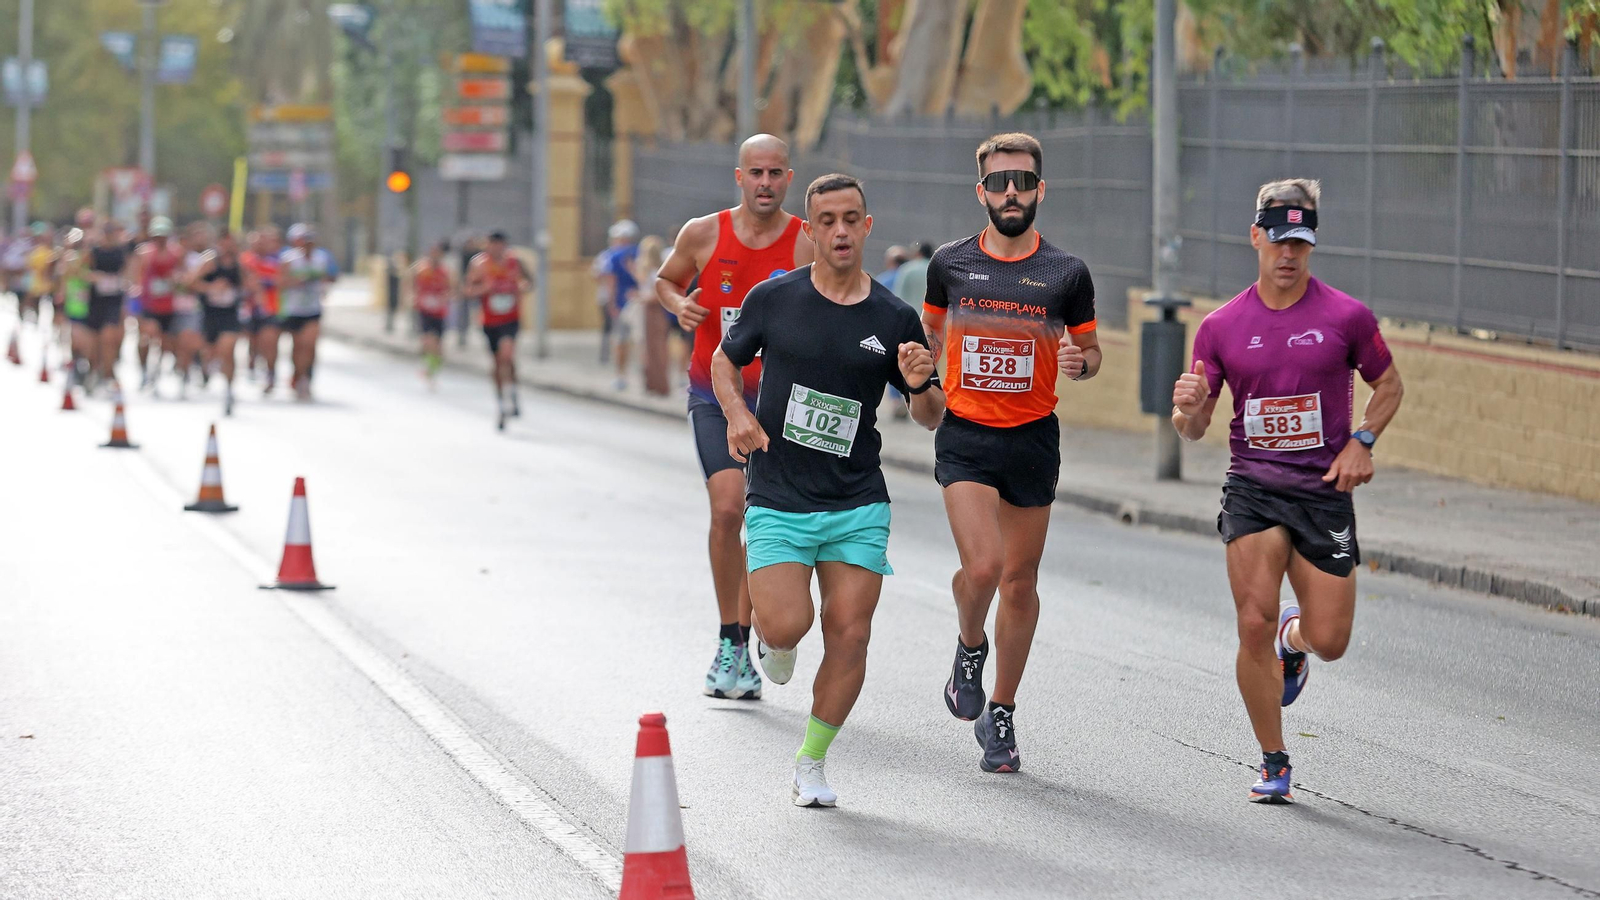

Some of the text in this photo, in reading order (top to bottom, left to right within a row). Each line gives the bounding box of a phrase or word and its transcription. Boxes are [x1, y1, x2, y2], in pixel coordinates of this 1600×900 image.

[960, 297, 1047, 315] C.A. CORREPLAYAS
[979, 355, 1016, 375] 528
[805, 409, 842, 435] 102
[1263, 415, 1302, 434] 583
